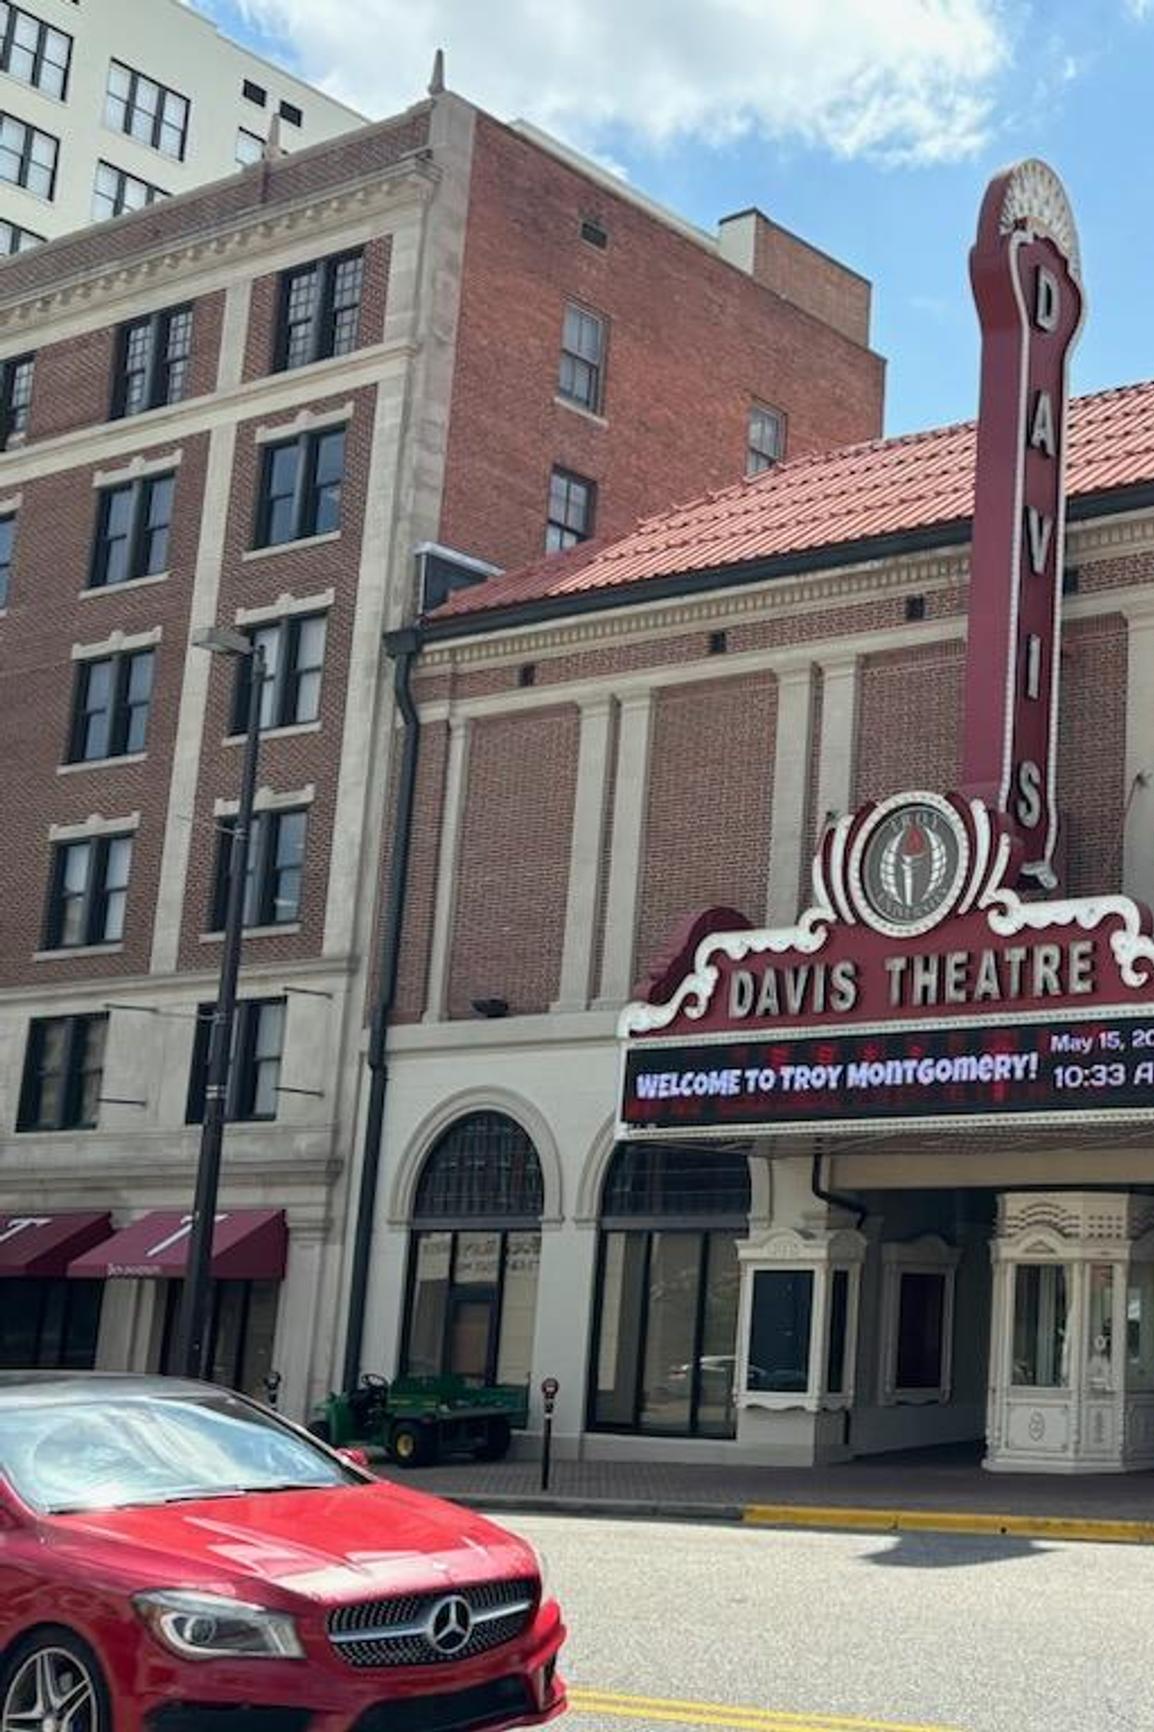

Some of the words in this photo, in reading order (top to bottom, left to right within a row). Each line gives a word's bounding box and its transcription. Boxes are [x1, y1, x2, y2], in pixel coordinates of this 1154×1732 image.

[1017, 263, 1058, 829] DAVIS
[728, 961, 857, 1019] DAVIS
[885, 939, 1094, 1007] THEATRE
[1051, 1034, 1093, 1053] May
[1099, 1031, 1125, 1051] 15,
[636, 1069, 742, 1100] WELCOME
[745, 1068, 776, 1091] TO
[781, 1064, 844, 1091] TROY
[1054, 1062, 1126, 1089] 10:33
